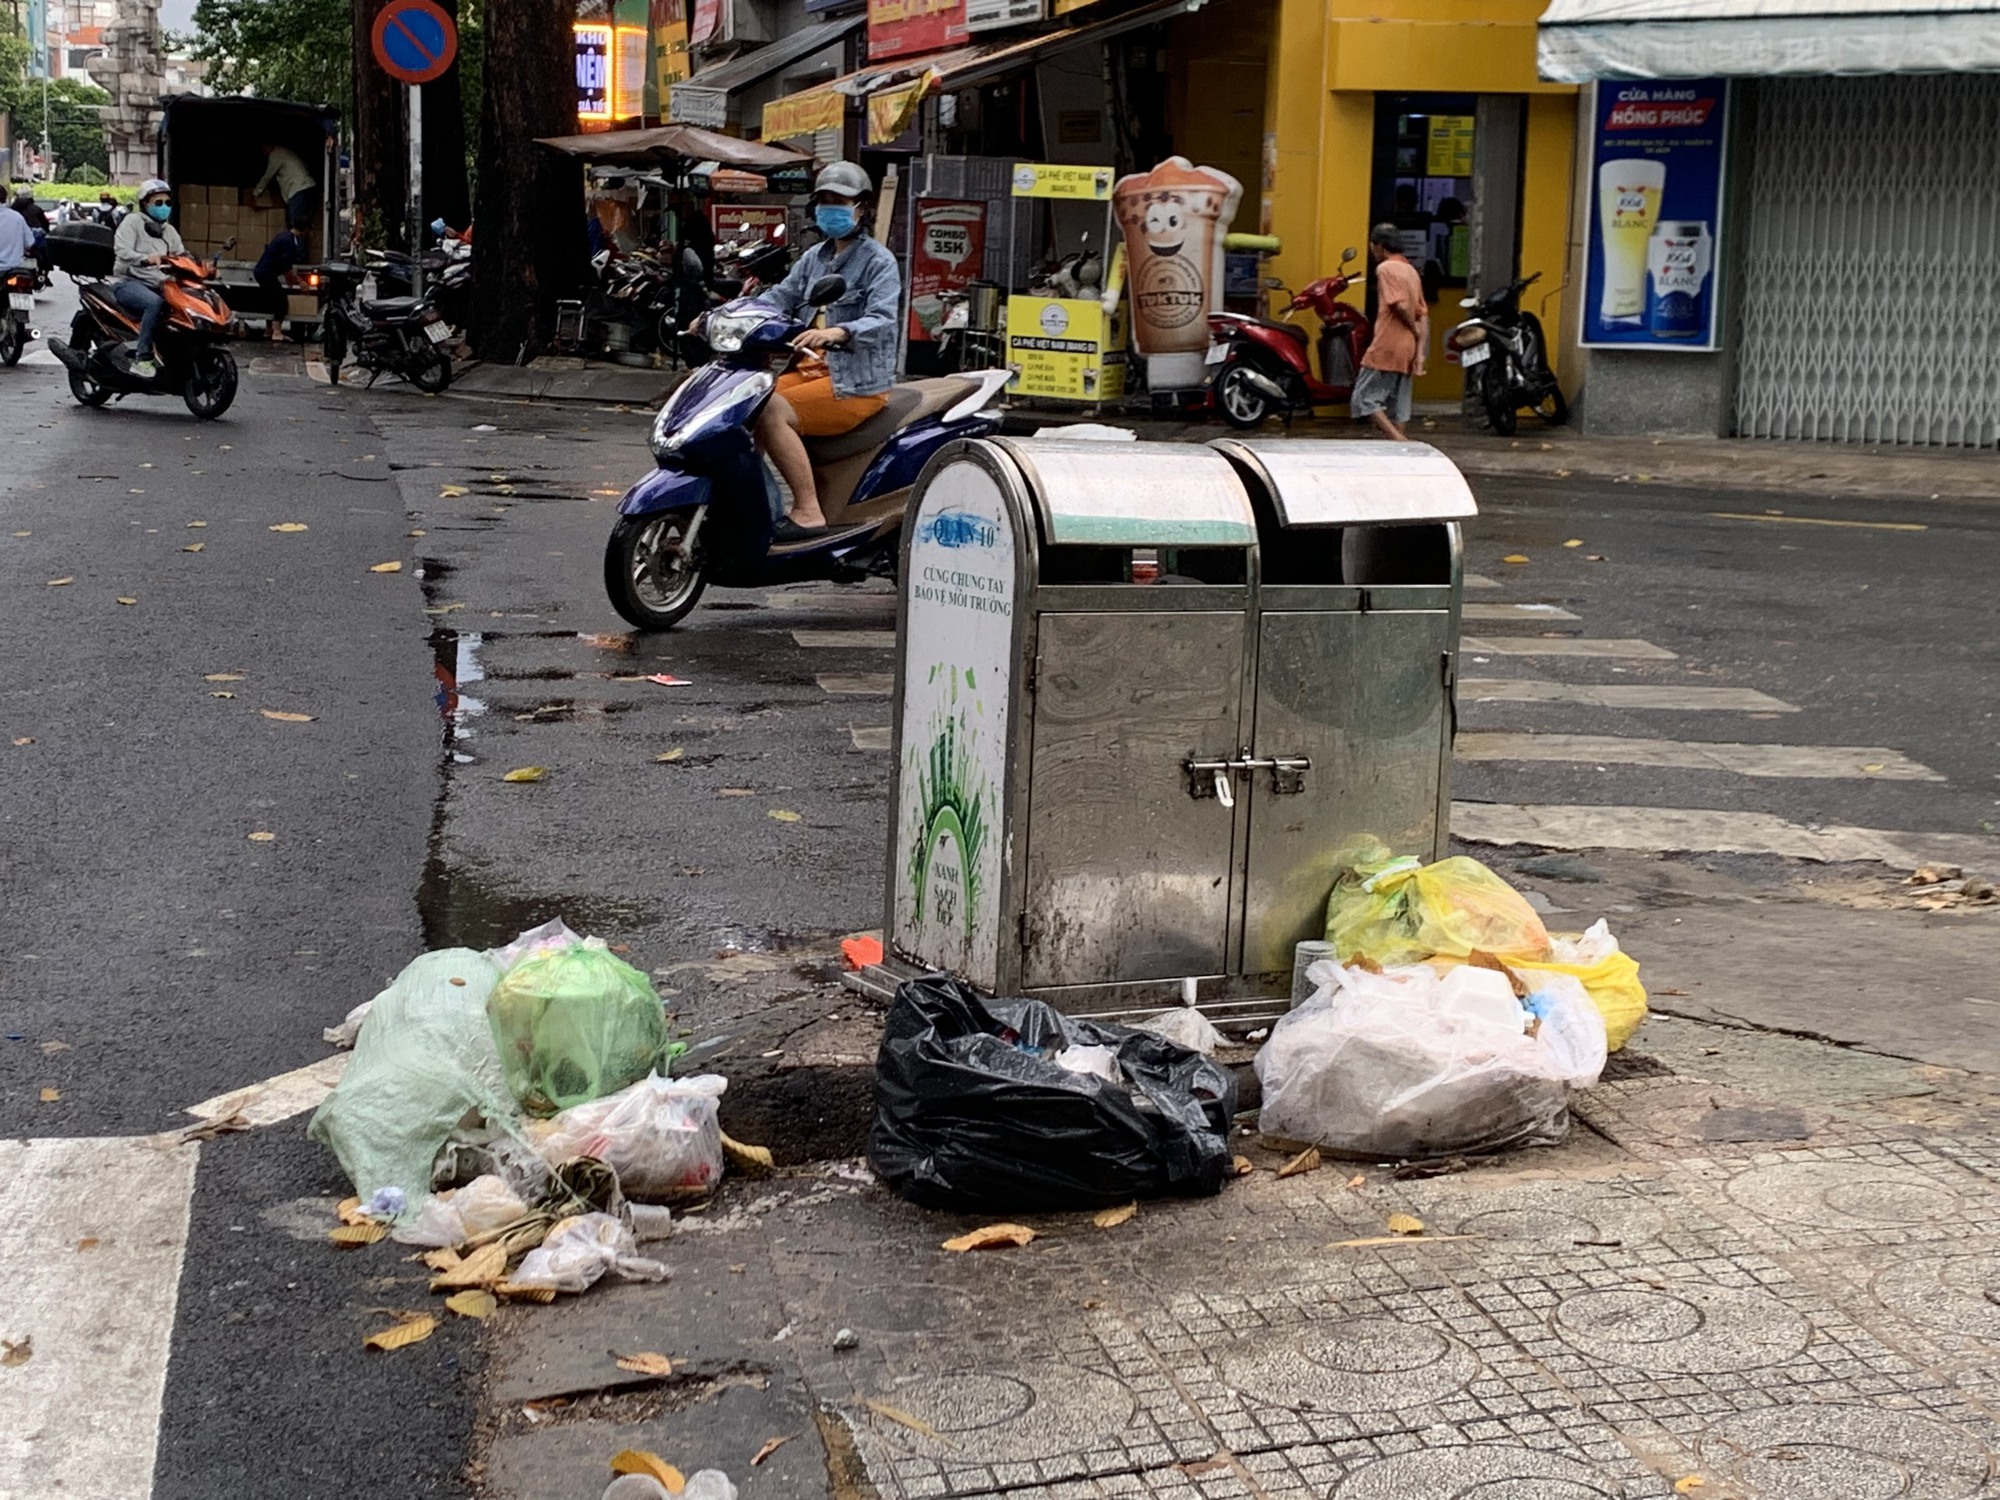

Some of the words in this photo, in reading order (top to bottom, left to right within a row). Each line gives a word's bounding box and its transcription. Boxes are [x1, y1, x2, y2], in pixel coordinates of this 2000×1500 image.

[1617, 85, 1650, 101] CỬA
[1660, 106, 1704, 124] PHÚC
[1612, 219, 1649, 228] BLANC
[929, 228, 967, 240] COMBO
[933, 240, 964, 254] 35K
[1659, 276, 1699, 286] BLANC
[980, 527, 995, 548] 10
[923, 564, 949, 583] CÙNG
[951, 571, 985, 590] CHUNG
[988, 579, 1004, 593] TAY
[914, 582, 934, 601] BẢO
[934, 587, 947, 607] VỆ
[948, 588, 968, 608] MÔI
[970, 594, 1011, 617] TRƯỜNG
[934, 862, 958, 884] XANH
